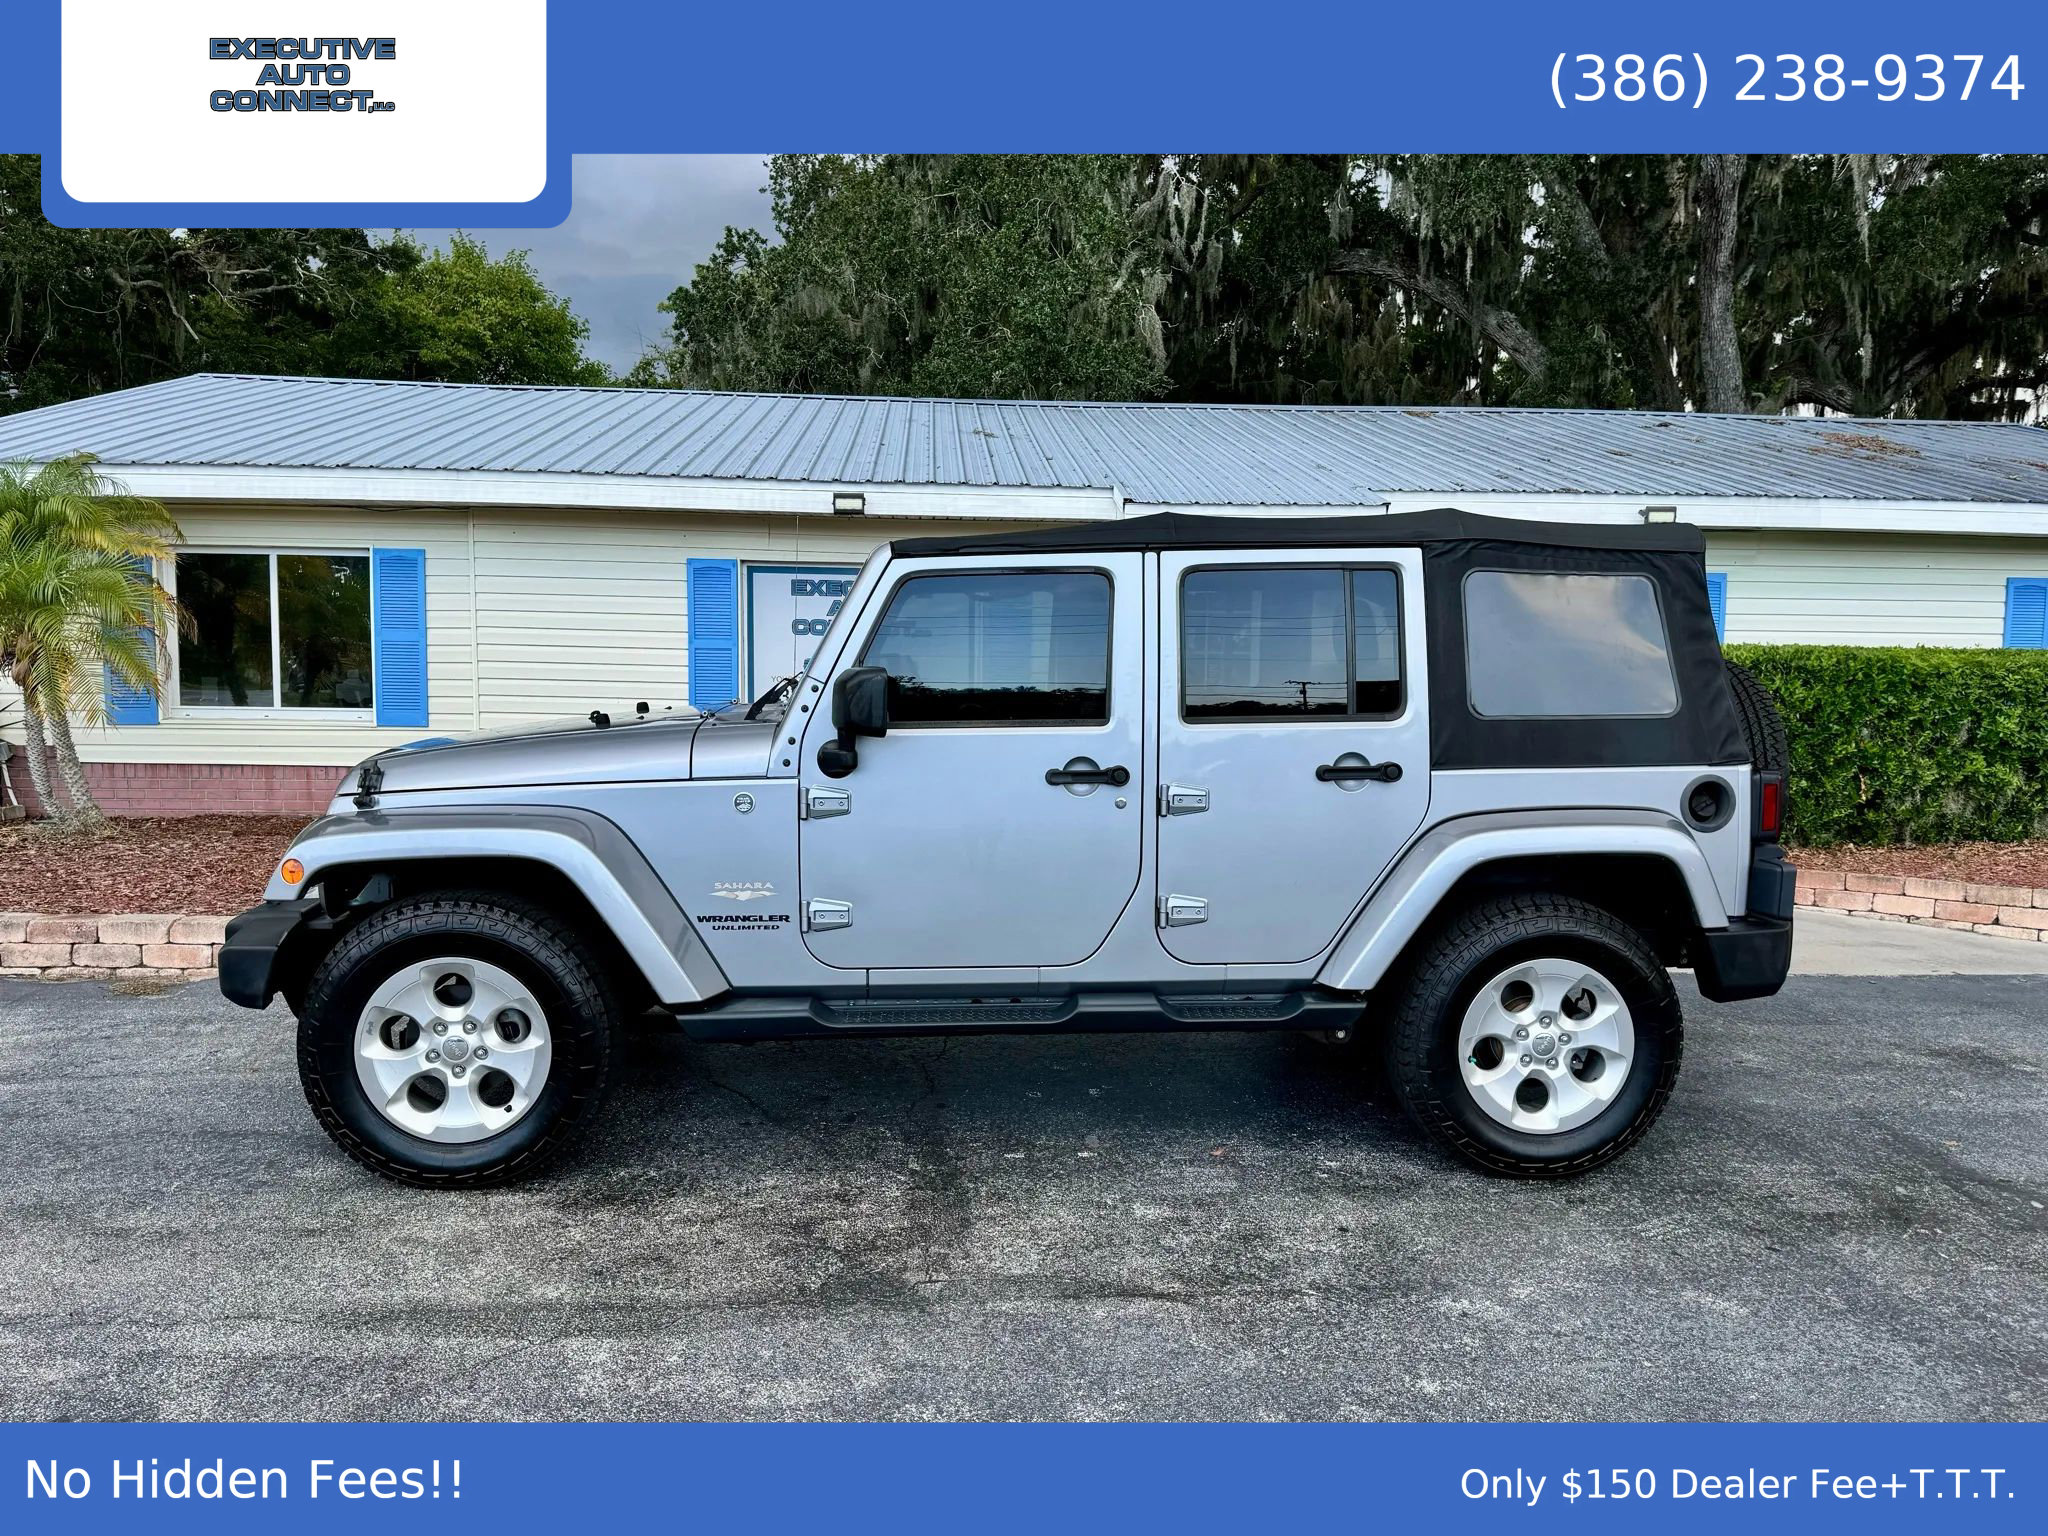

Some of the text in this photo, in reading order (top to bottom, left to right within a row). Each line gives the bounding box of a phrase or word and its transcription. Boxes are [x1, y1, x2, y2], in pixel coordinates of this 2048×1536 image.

[792, 618, 832, 636] CO
[714, 881, 774, 890] SAHARA
[696, 914, 791, 924] WRANGLER
